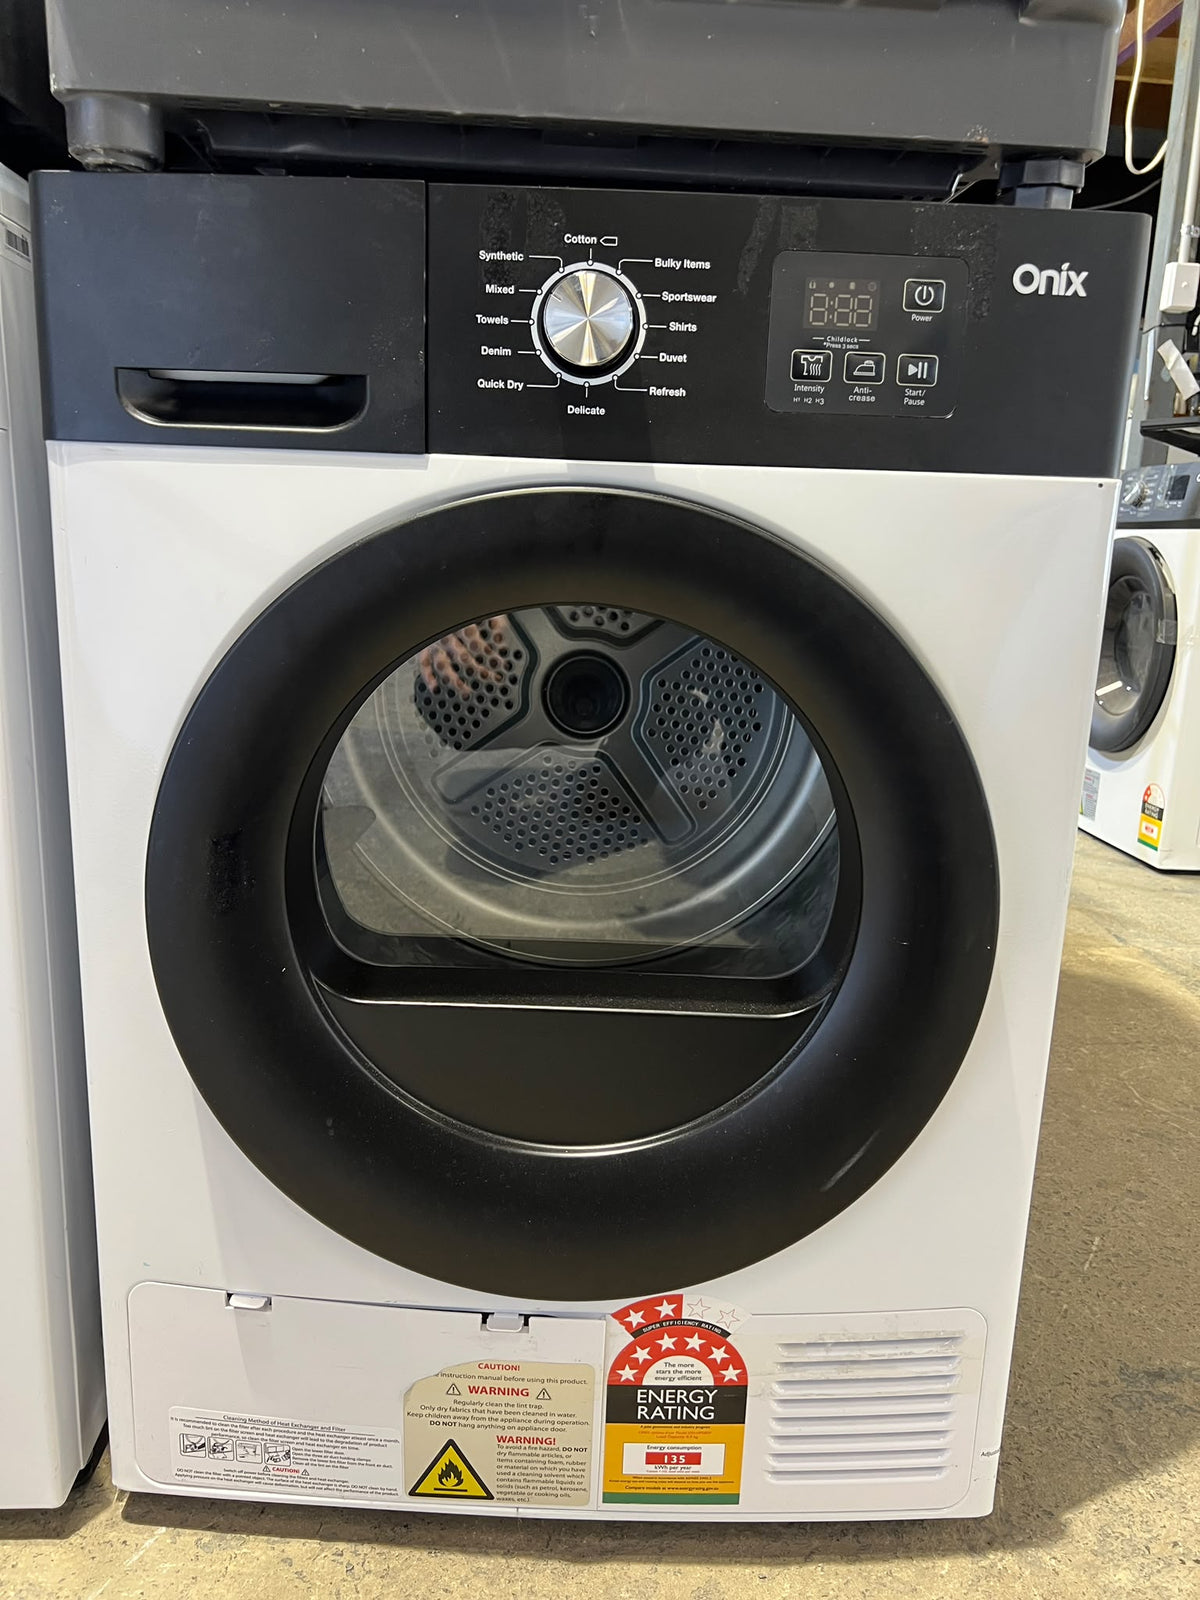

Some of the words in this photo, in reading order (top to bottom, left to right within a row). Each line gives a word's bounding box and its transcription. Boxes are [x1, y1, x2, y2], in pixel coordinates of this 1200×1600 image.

[564, 234, 597, 244] Cotton
[479, 250, 523, 262] Synthetic
[654, 257, 681, 269] Bulky
[683, 258, 710, 268] Items
[1012, 262, 1088, 297] Onix
[485, 285, 514, 294] Mixed
[662, 292, 716, 304] Sportswear
[475, 315, 508, 324] Towels
[911, 314, 932, 322] Power
[669, 322, 697, 331] Shirts
[481, 346, 511, 356] Denim
[659, 353, 687, 363] Duvet
[477, 380, 504, 389] Quick
[507, 380, 523, 391] Dry
[794, 384, 824, 394] Intensity
[853, 386, 871, 394] Anti-
[649, 387, 685, 396] Refresh
[904, 388, 925, 397] Start/
[903, 397, 924, 406] Pause
[567, 406, 605, 415] Delicate
[642, 1324, 660, 1332] SUPER
[701, 1324, 722, 1334] RATING
[478, 1362, 519, 1371] CAUTION!
[468, 1385, 528, 1396] WARNING
[637, 1389, 717, 1404] ENERGY
[637, 1405, 714, 1420] RATING
[223, 1414, 246, 1423] Cleaning
[291, 1421, 318, 1430] Exchanger
[496, 1436, 555, 1445] WARNING!
[664, 1455, 685, 1463] 135
